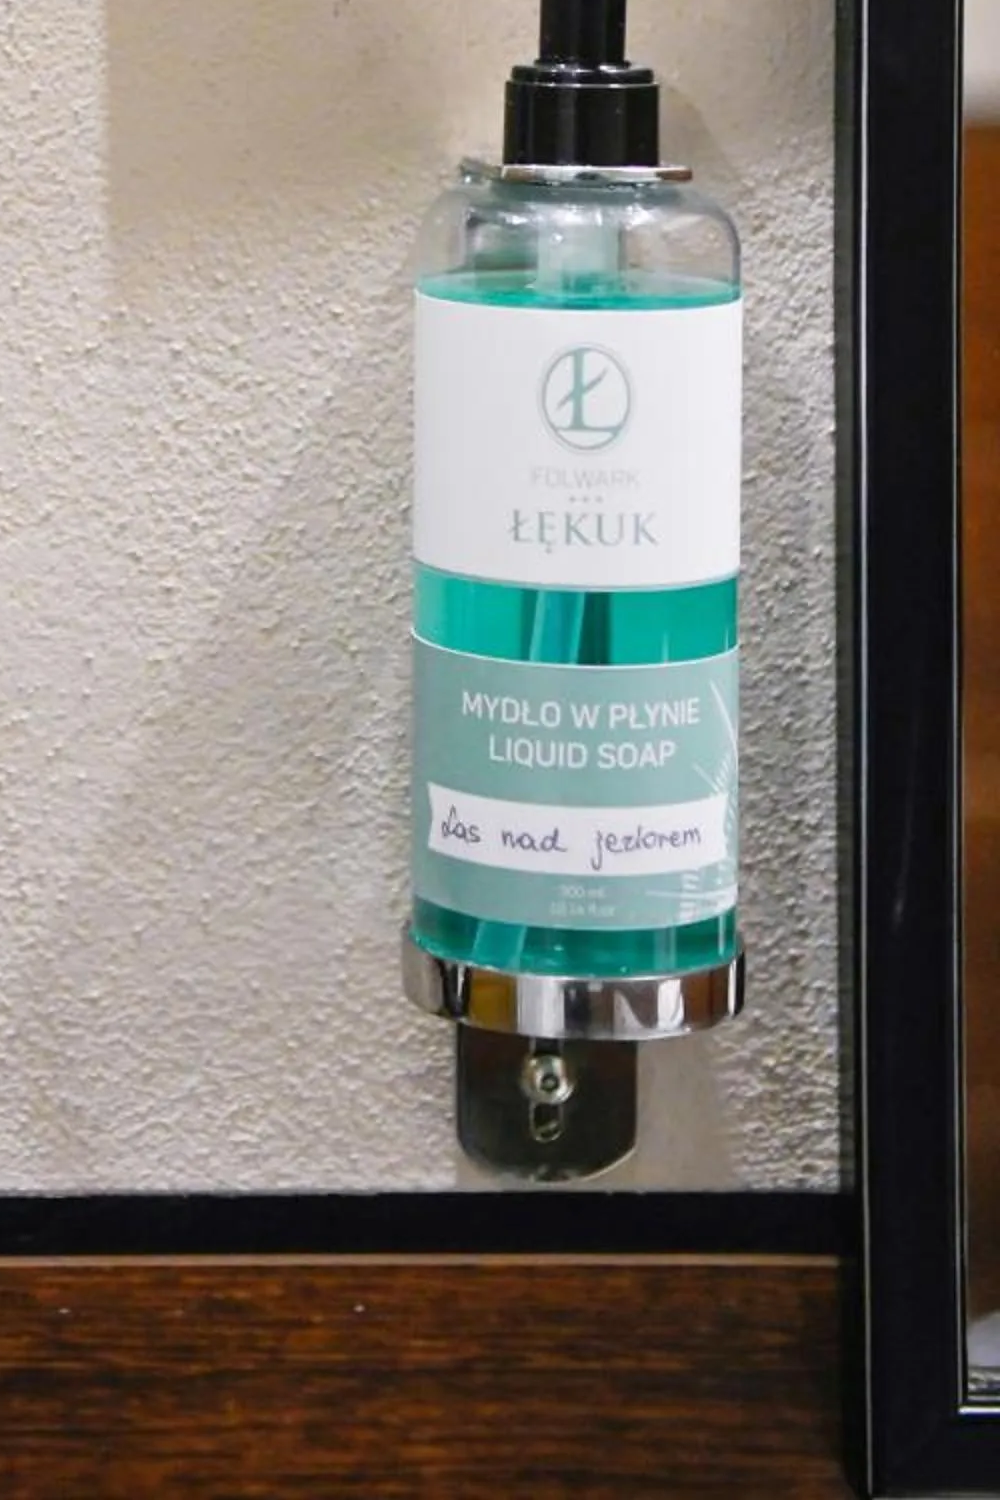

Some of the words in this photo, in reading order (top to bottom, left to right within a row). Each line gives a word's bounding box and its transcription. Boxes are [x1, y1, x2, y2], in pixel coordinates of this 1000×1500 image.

[508, 508, 660, 555] ŁĘKUK
[462, 690, 562, 729] MYDŁO
[570, 702, 601, 730] W
[609, 696, 702, 730] PŁYNIE
[488, 734, 589, 770] LIQUID
[597, 739, 678, 770] SOAP
[500, 826, 568, 852] nad
